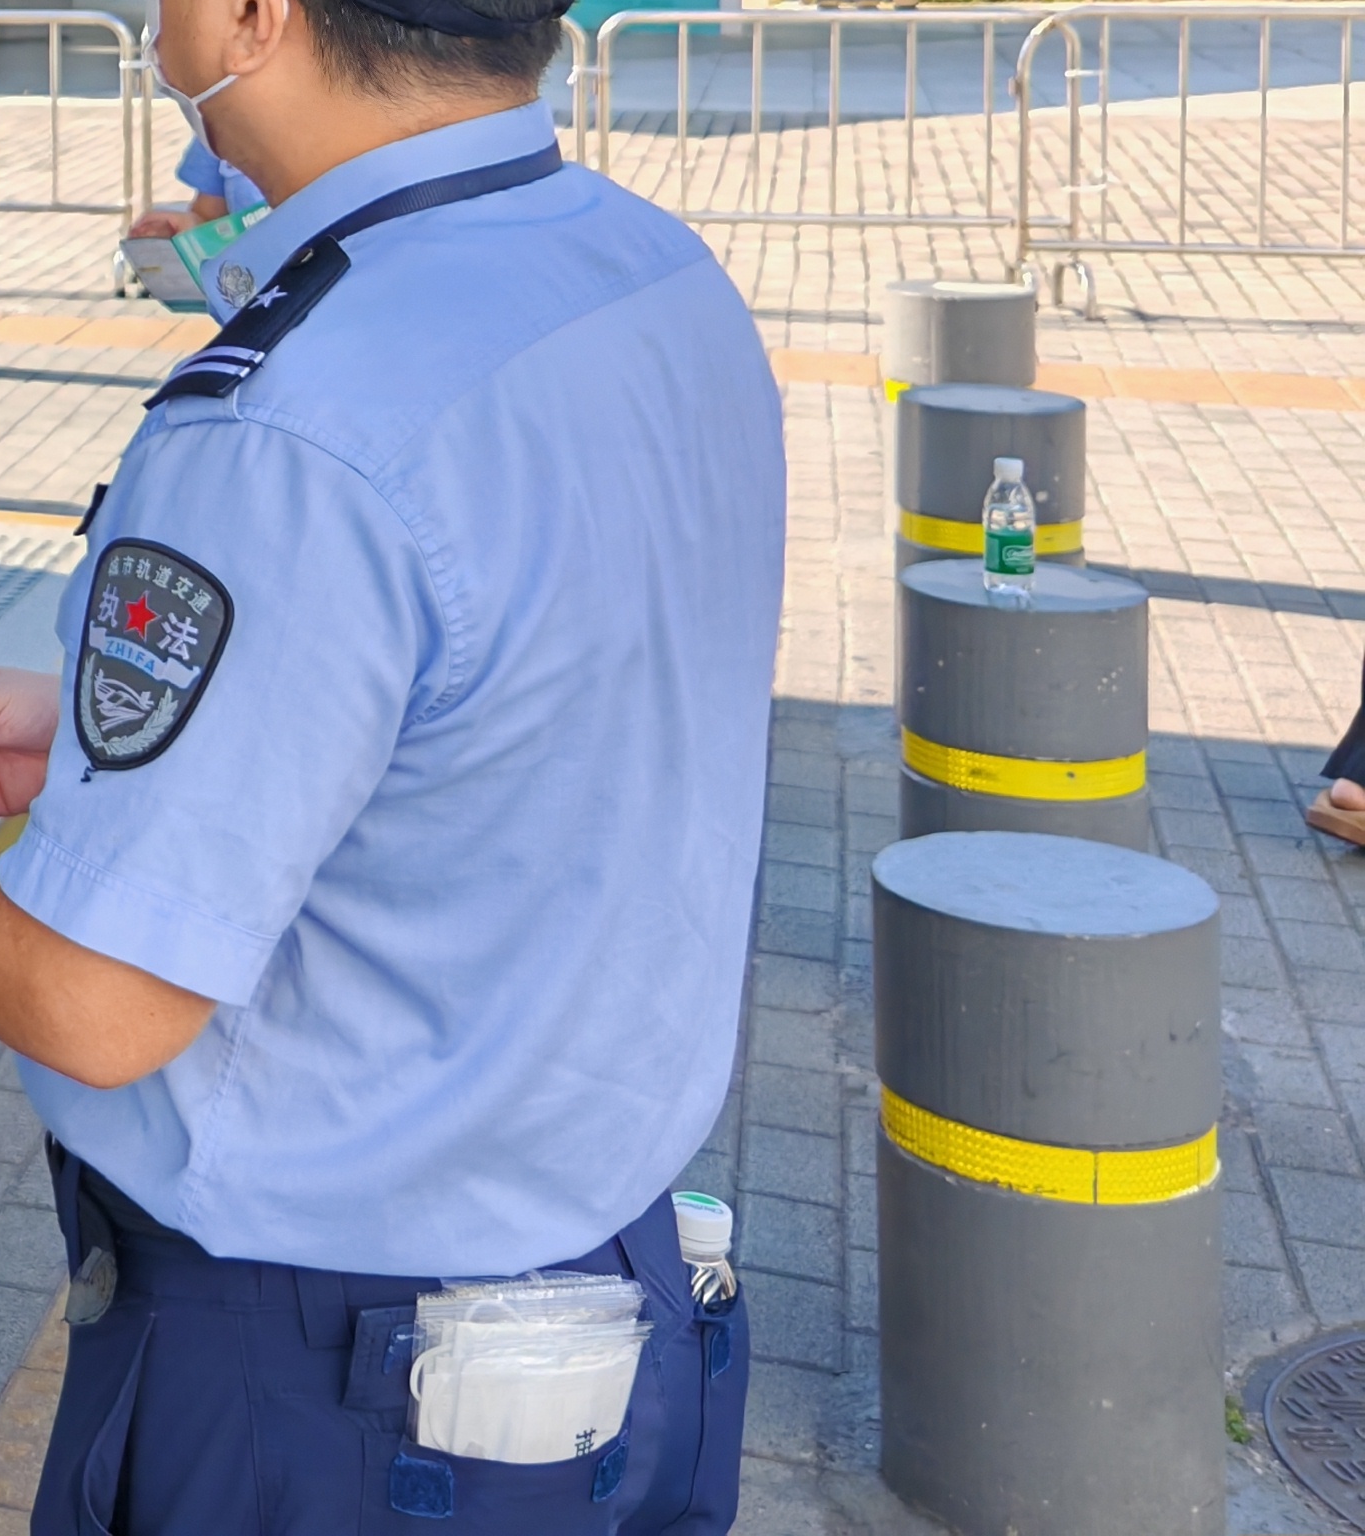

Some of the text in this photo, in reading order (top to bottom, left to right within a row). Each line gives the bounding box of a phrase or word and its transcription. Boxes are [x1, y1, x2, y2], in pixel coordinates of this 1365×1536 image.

[108, 554, 213, 617] 城市轨道交通
[105, 640, 156, 673] ZHIFA
